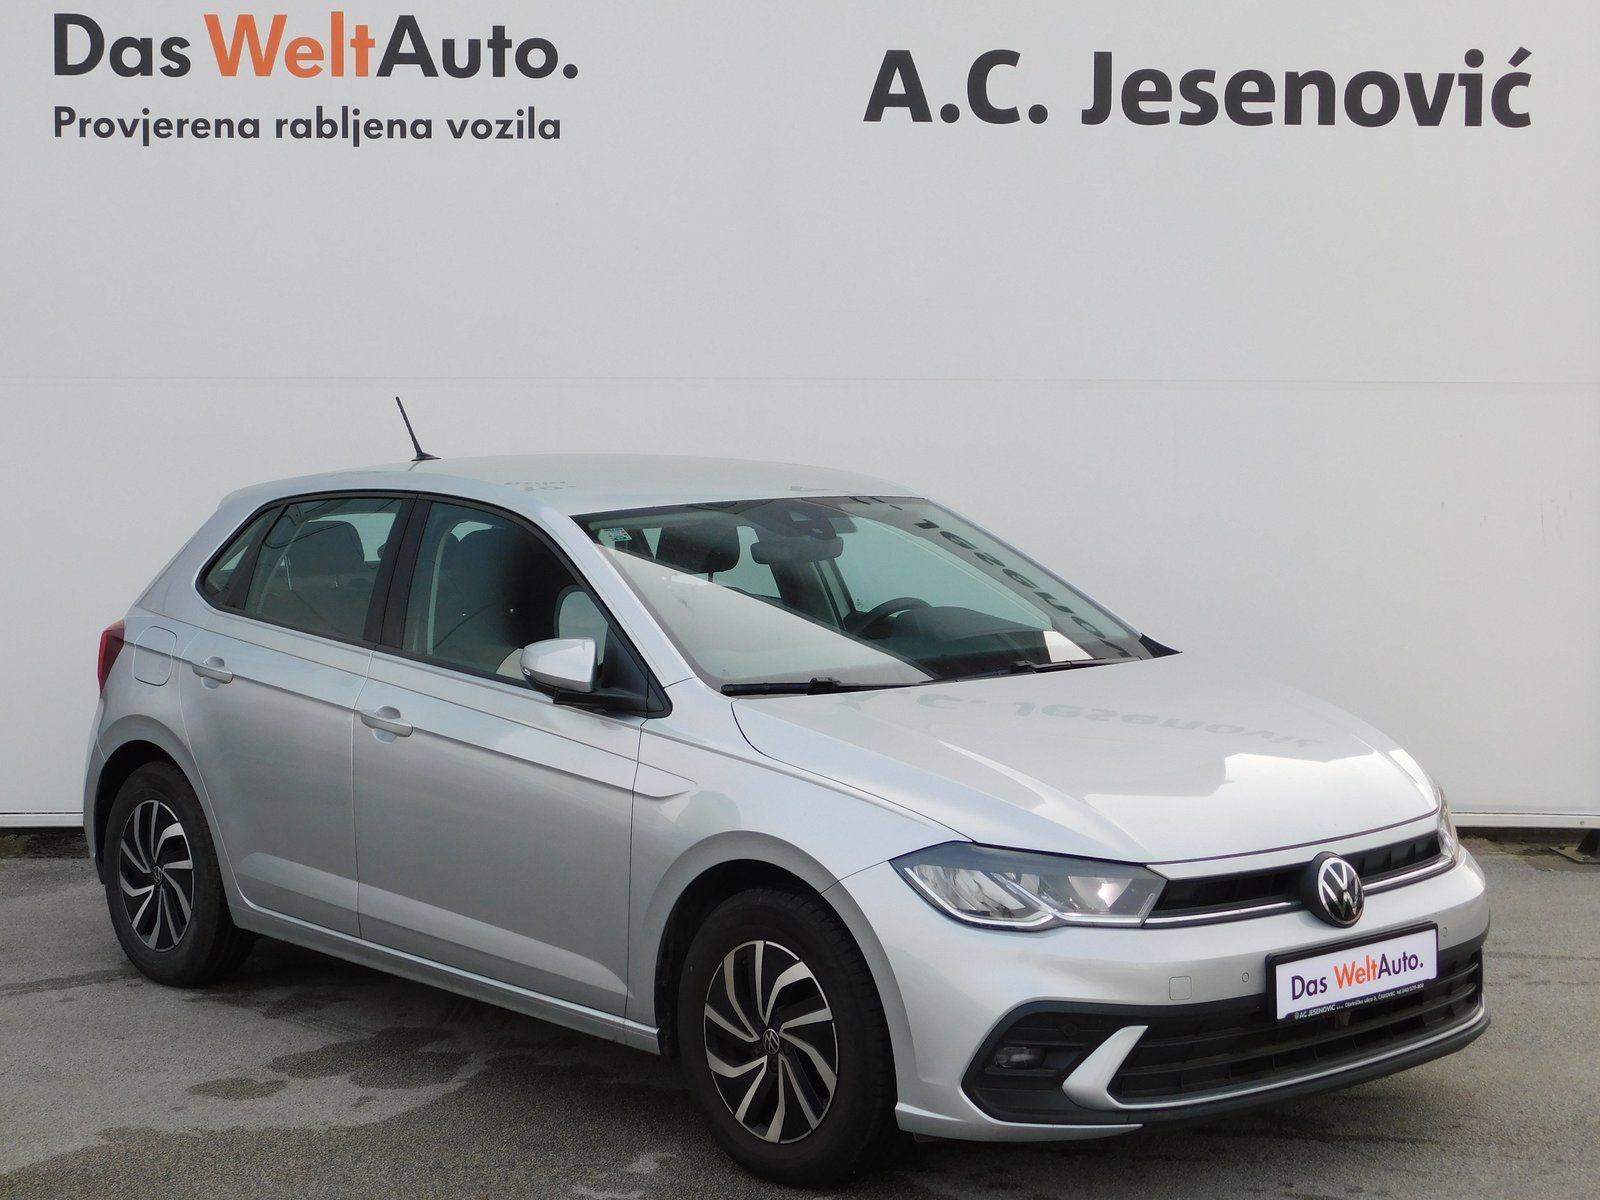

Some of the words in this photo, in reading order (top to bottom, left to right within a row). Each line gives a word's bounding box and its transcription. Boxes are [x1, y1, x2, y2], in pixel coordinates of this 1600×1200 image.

[54, 13, 191, 77] Das
[204, 11, 578, 79] WeltAuto.
[863, 48, 1048, 125] A.C.
[1082, 46, 1533, 128] Jesenović
[54, 105, 260, 147] Provjerena
[275, 105, 433, 147] rabljena
[445, 105, 561, 140] vozila
[1291, 975, 1327, 1001] Das
[1334, 951, 1424, 990] WeltAuto.
